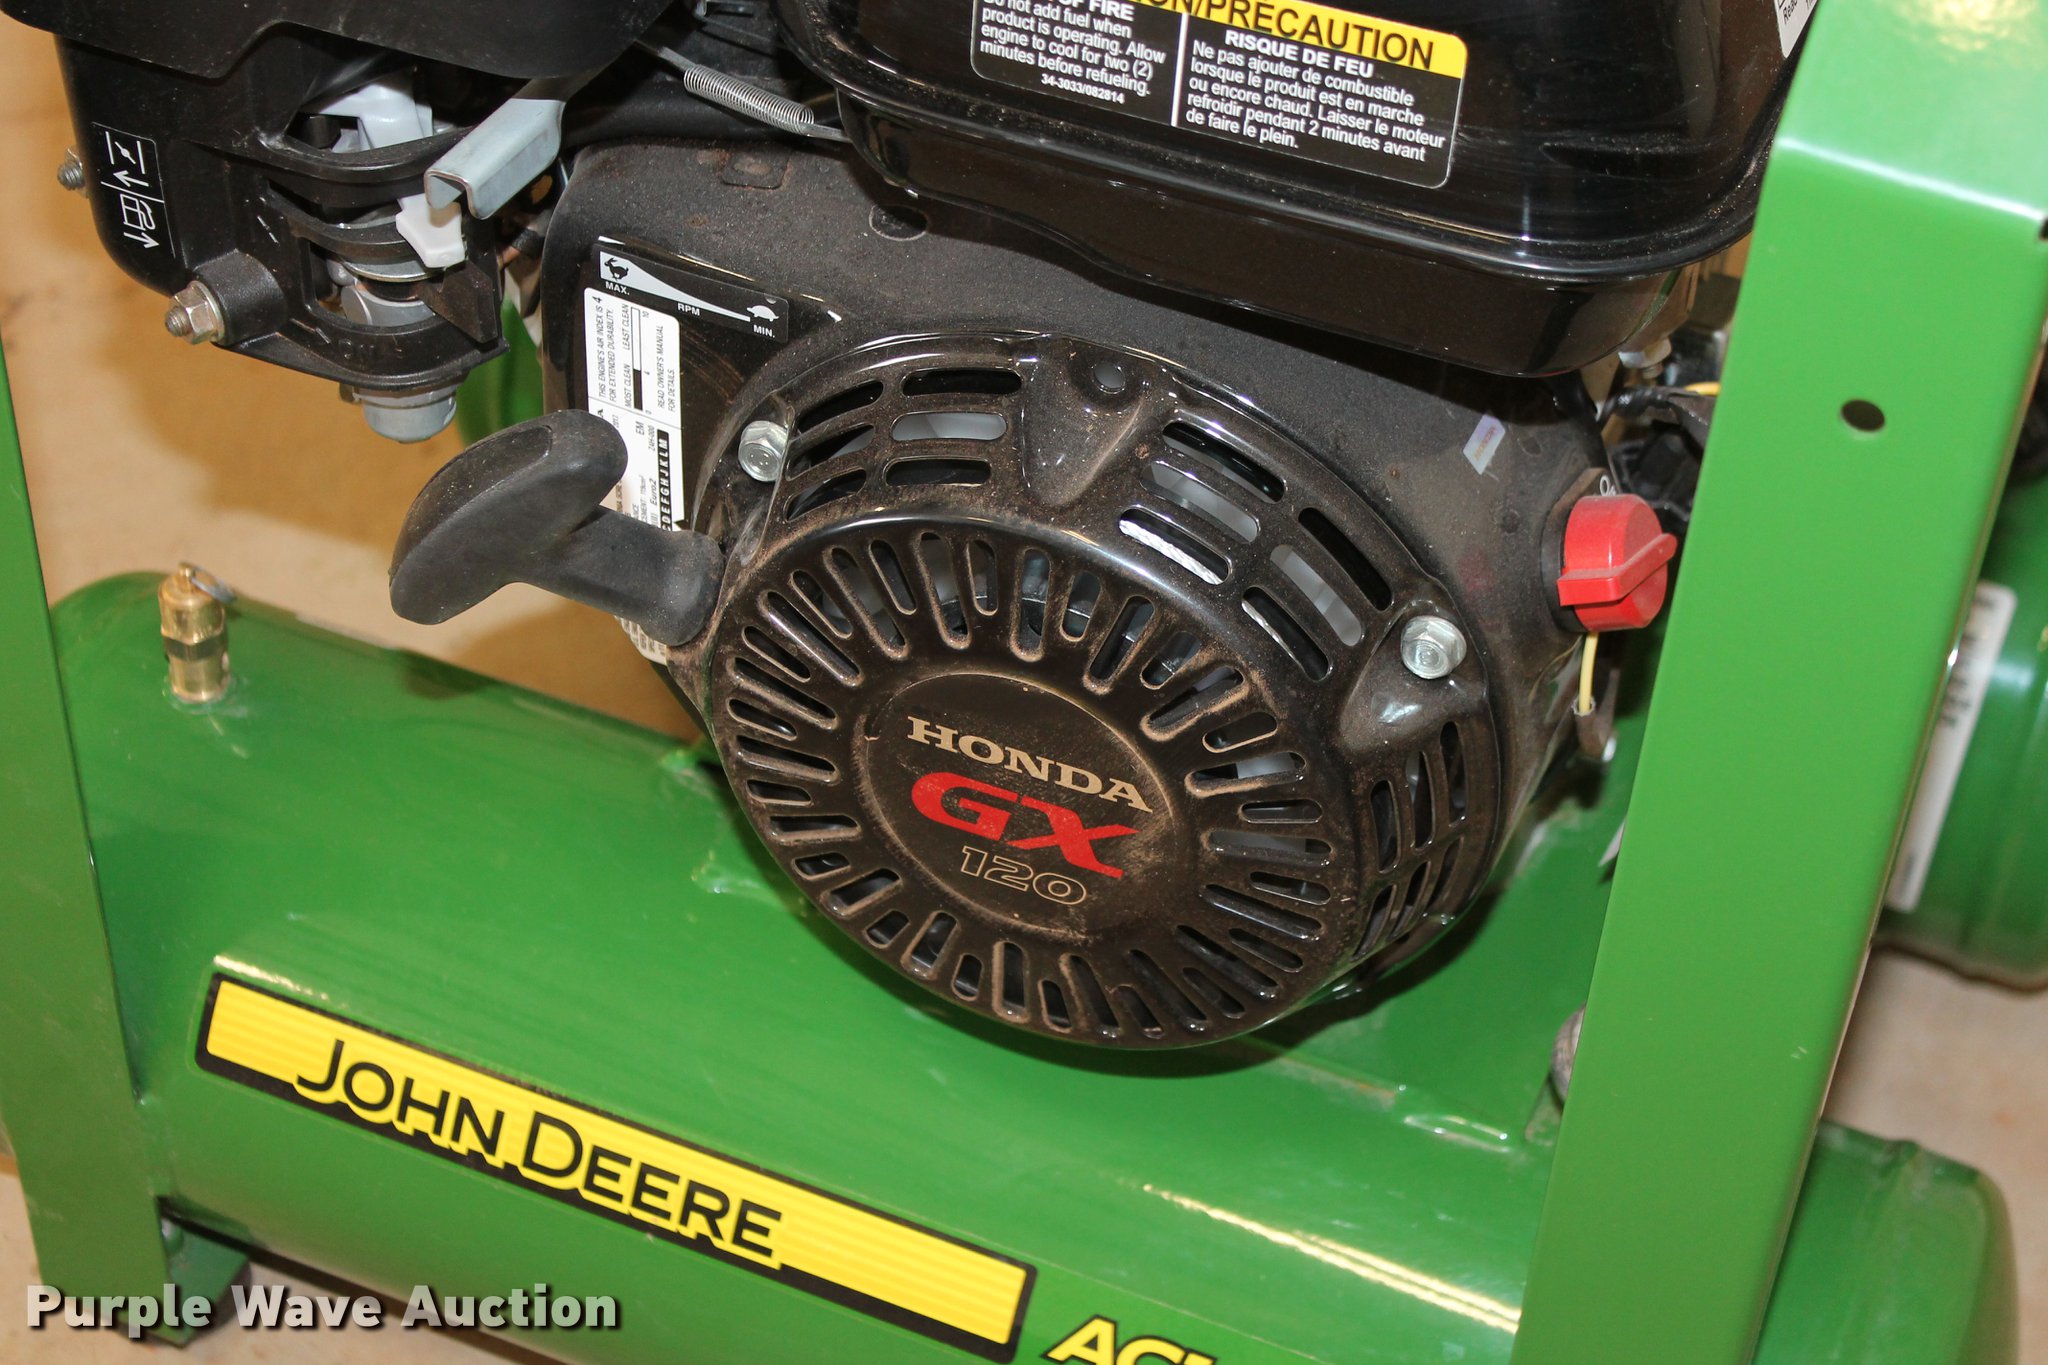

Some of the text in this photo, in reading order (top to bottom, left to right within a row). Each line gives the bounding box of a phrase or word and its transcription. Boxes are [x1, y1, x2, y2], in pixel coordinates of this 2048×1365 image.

[982, 7, 1166, 64] product is operating. Allow
[1033, 3, 1062, 21] add
[1063, 7, 1090, 28] fuel
[1093, 18, 1132, 38] when
[1089, 0, 1135, 21] FIRE
[980, 39, 1151, 97] minutes before refueling.
[981, 24, 1153, 80] engine to cool for two (2)
[1193, 39, 1414, 107] Ne pas ajouter de combustible
[1225, 29, 1374, 78] RISQUE DE FEU
[1189, 77, 1446, 149] ou encore chaud. Laisser le moteur
[1190, 59, 1425, 126] lorsque le produit est en marche
[1185, 108, 1299, 149] de faire le plein.
[1187, 92, 1426, 162] refroidir pendant 2 minutes avant
[605, 281, 630, 296] MAX.
[677, 303, 700, 316] RPM
[622, 304, 630, 327] CLEAN
[753, 324, 776, 338] MIN.
[598, 383, 606, 397] THIS
[608, 351, 616, 387] EXTENDED
[623, 364, 632, 407] MOST CLEAN
[907, 716, 1153, 813] HONDA
[911, 771, 1141, 879] GX
[960, 845, 1087, 905] 120
[297, 1038, 782, 1258] JOHN DEERE
